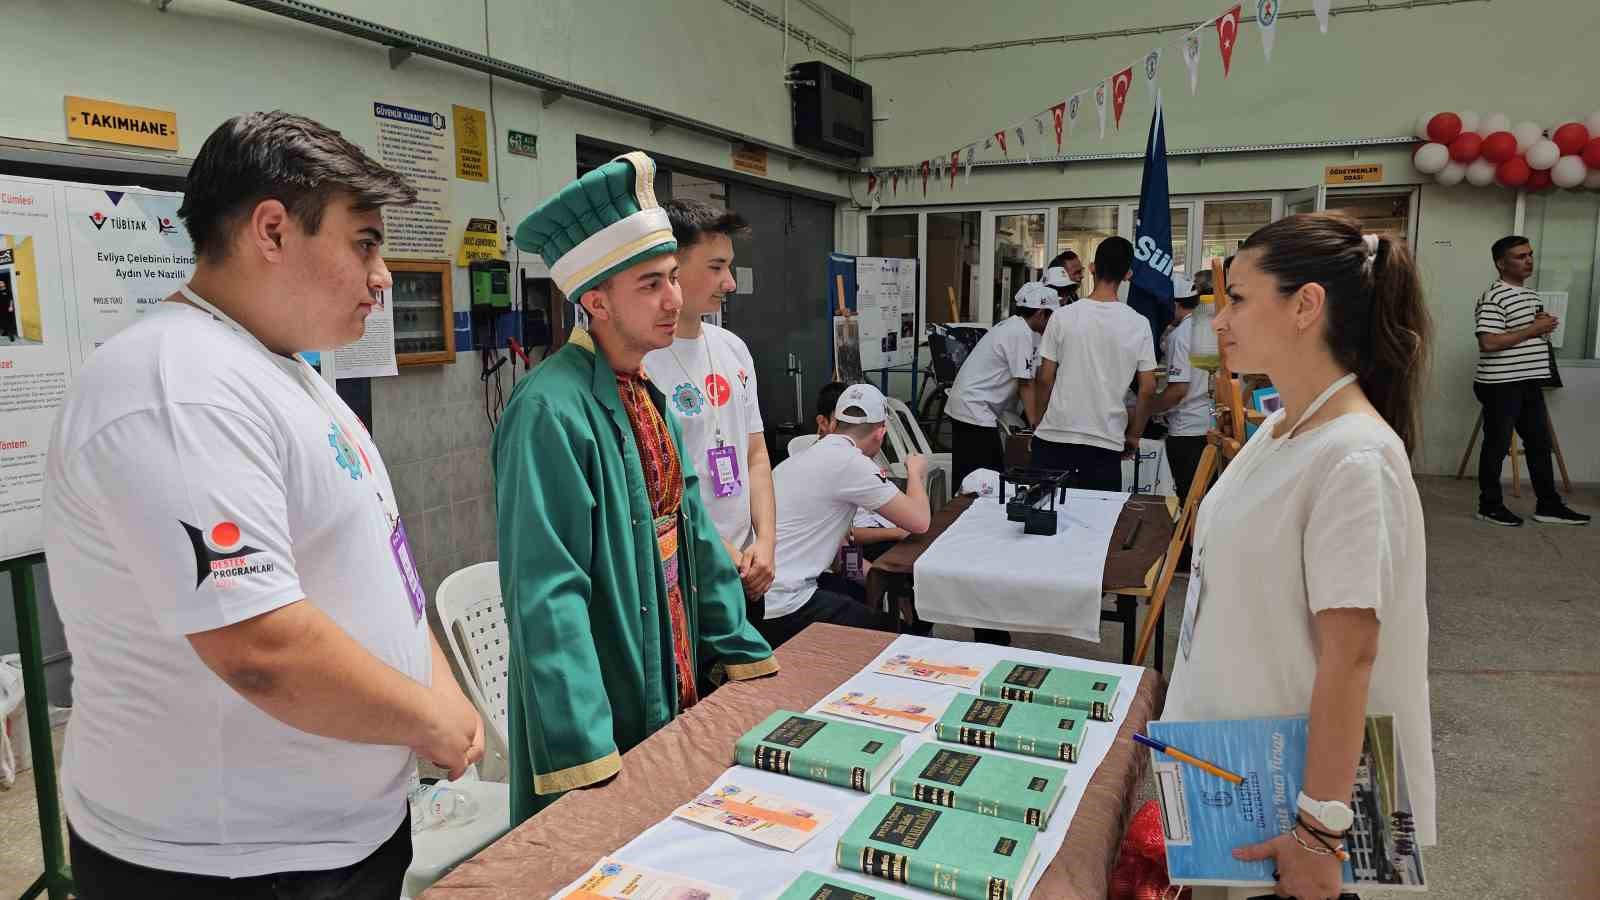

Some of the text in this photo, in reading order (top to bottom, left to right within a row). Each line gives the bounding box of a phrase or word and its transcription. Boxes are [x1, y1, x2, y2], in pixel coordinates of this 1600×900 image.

[80, 111, 168, 137] TAKIMHANE
[111, 217, 148, 231] TÜBİTAK
[97, 251, 126, 265] Evliya
[127, 253, 171, 264] Çelebinin
[115, 268, 186, 280] Aydın Ve Nazilli
[211, 558, 247, 570] DESTEK
[213, 562, 275, 580] PROGRAMLARI
